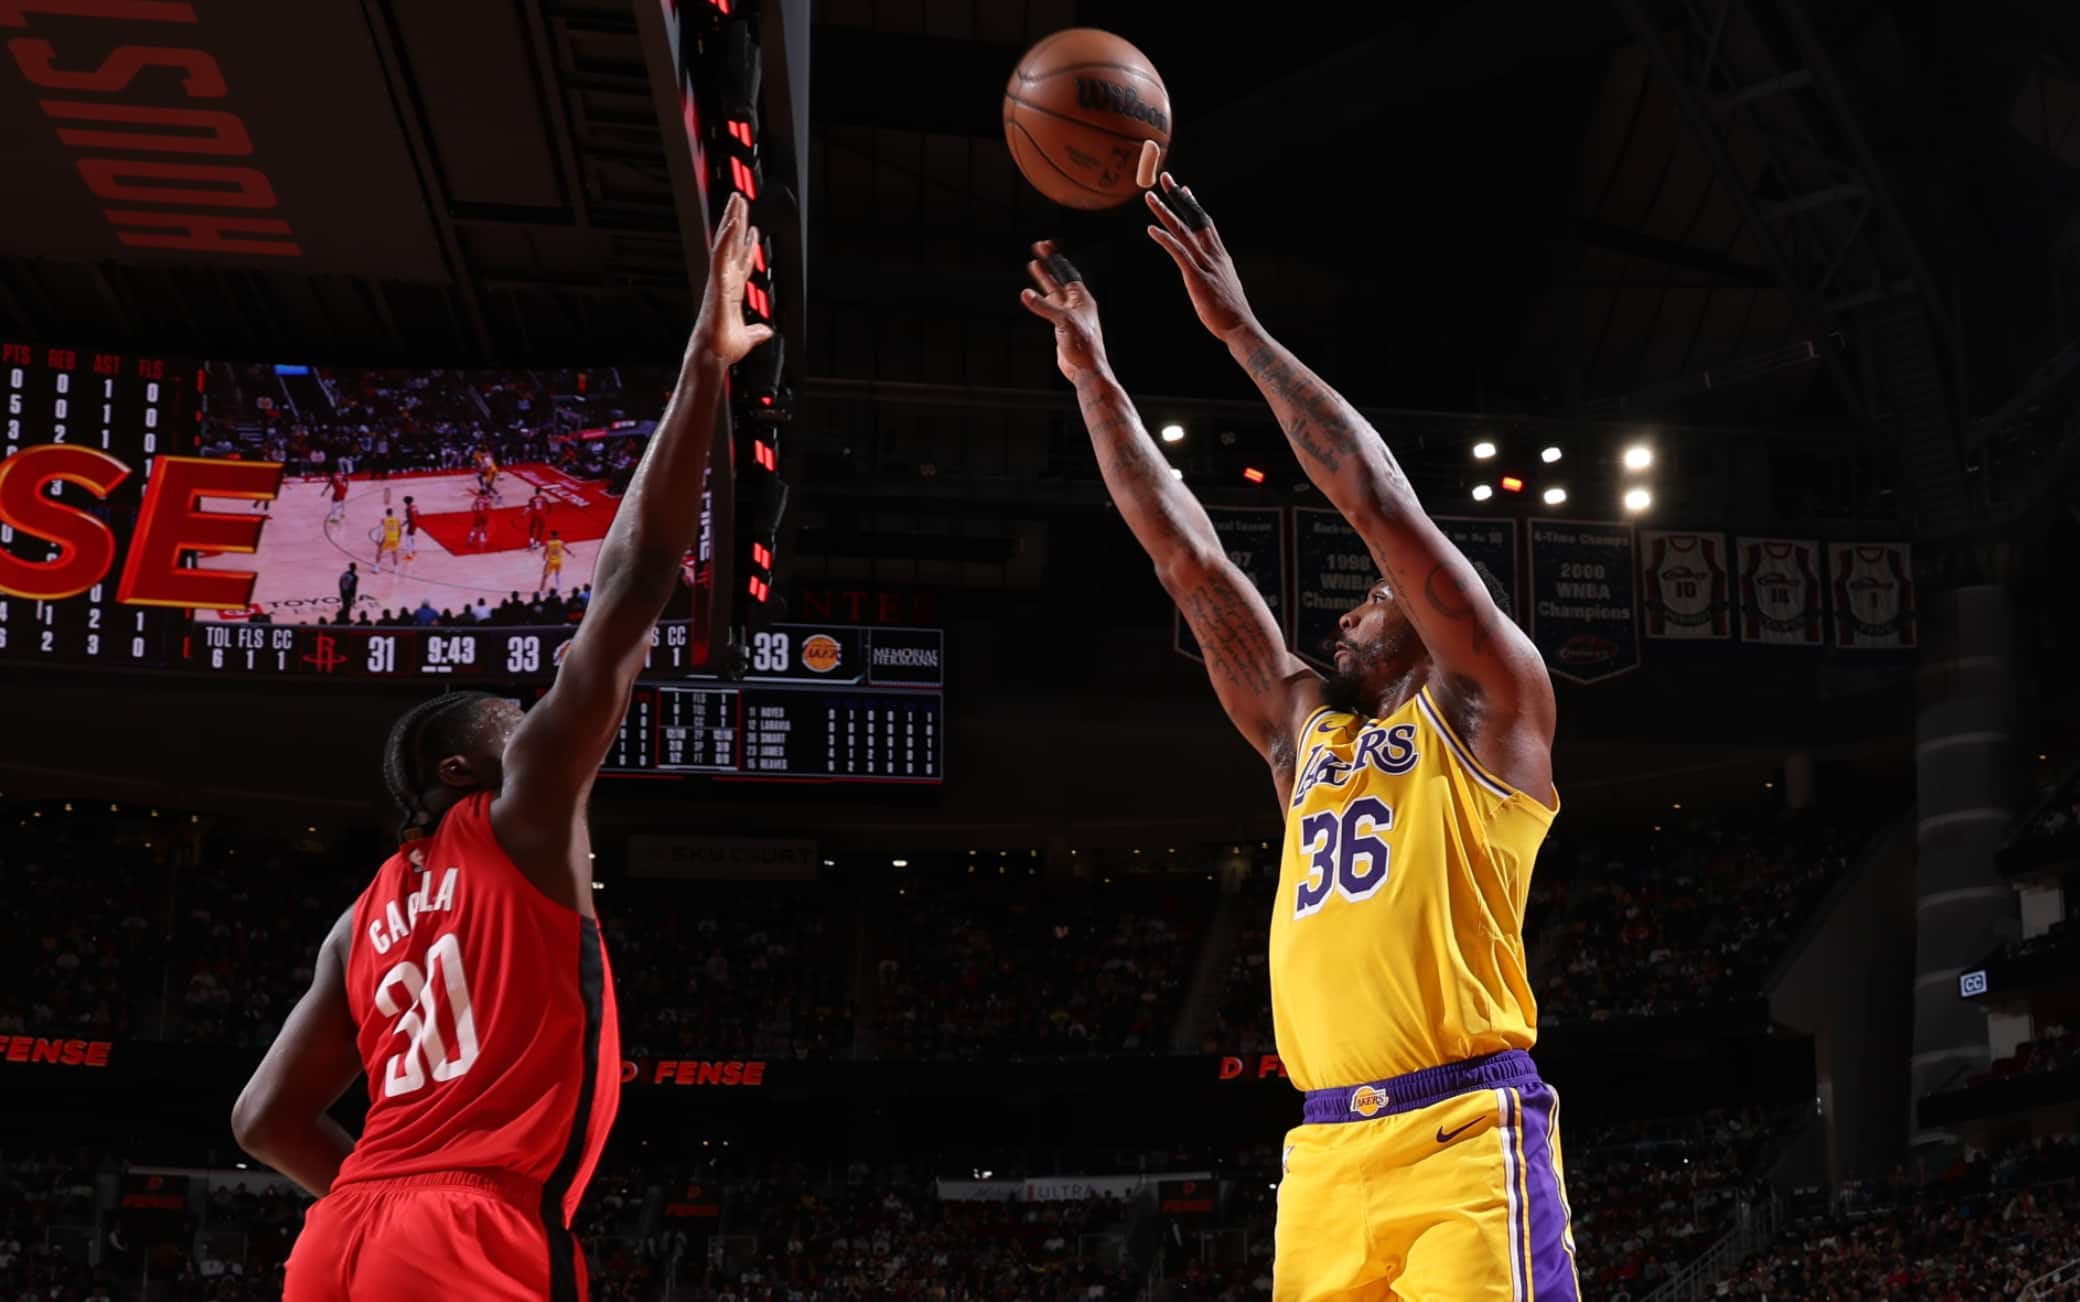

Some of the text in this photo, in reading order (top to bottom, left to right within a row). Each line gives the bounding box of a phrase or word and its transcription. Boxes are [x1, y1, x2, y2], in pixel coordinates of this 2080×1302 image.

[3, 344, 164, 380] PTS REB AST FLS
[10, 368, 159, 403] 0 0 1 0
[9, 393, 157, 428] 5 0 1 0
[7, 419, 156, 453] 3 2 1 0
[1559, 562, 1606, 580] 2000
[1554, 583, 1611, 601] WNBA
[88, 608, 101, 629] 2
[136, 611, 144, 632] 1
[1537, 601, 1631, 622] Champions
[41, 630, 53, 652] 2
[87, 634, 99, 655] 3
[132, 637, 145, 658] 0
[205, 627, 292, 649] TOL FLS CC
[427, 636, 476, 664] 9:43
[667, 626, 687, 646] CC
[212, 649, 285, 670] 6 1 1
[367, 636, 395, 672] 31
[506, 636, 540, 672] 33
[672, 647, 680, 667] 1
[753, 632, 790, 672] 33
[1294, 797, 1394, 919] 36
[375, 933, 479, 1098] 30
[653, 1061, 766, 1086] FENSE
[1218, 1056, 1243, 1080] D
